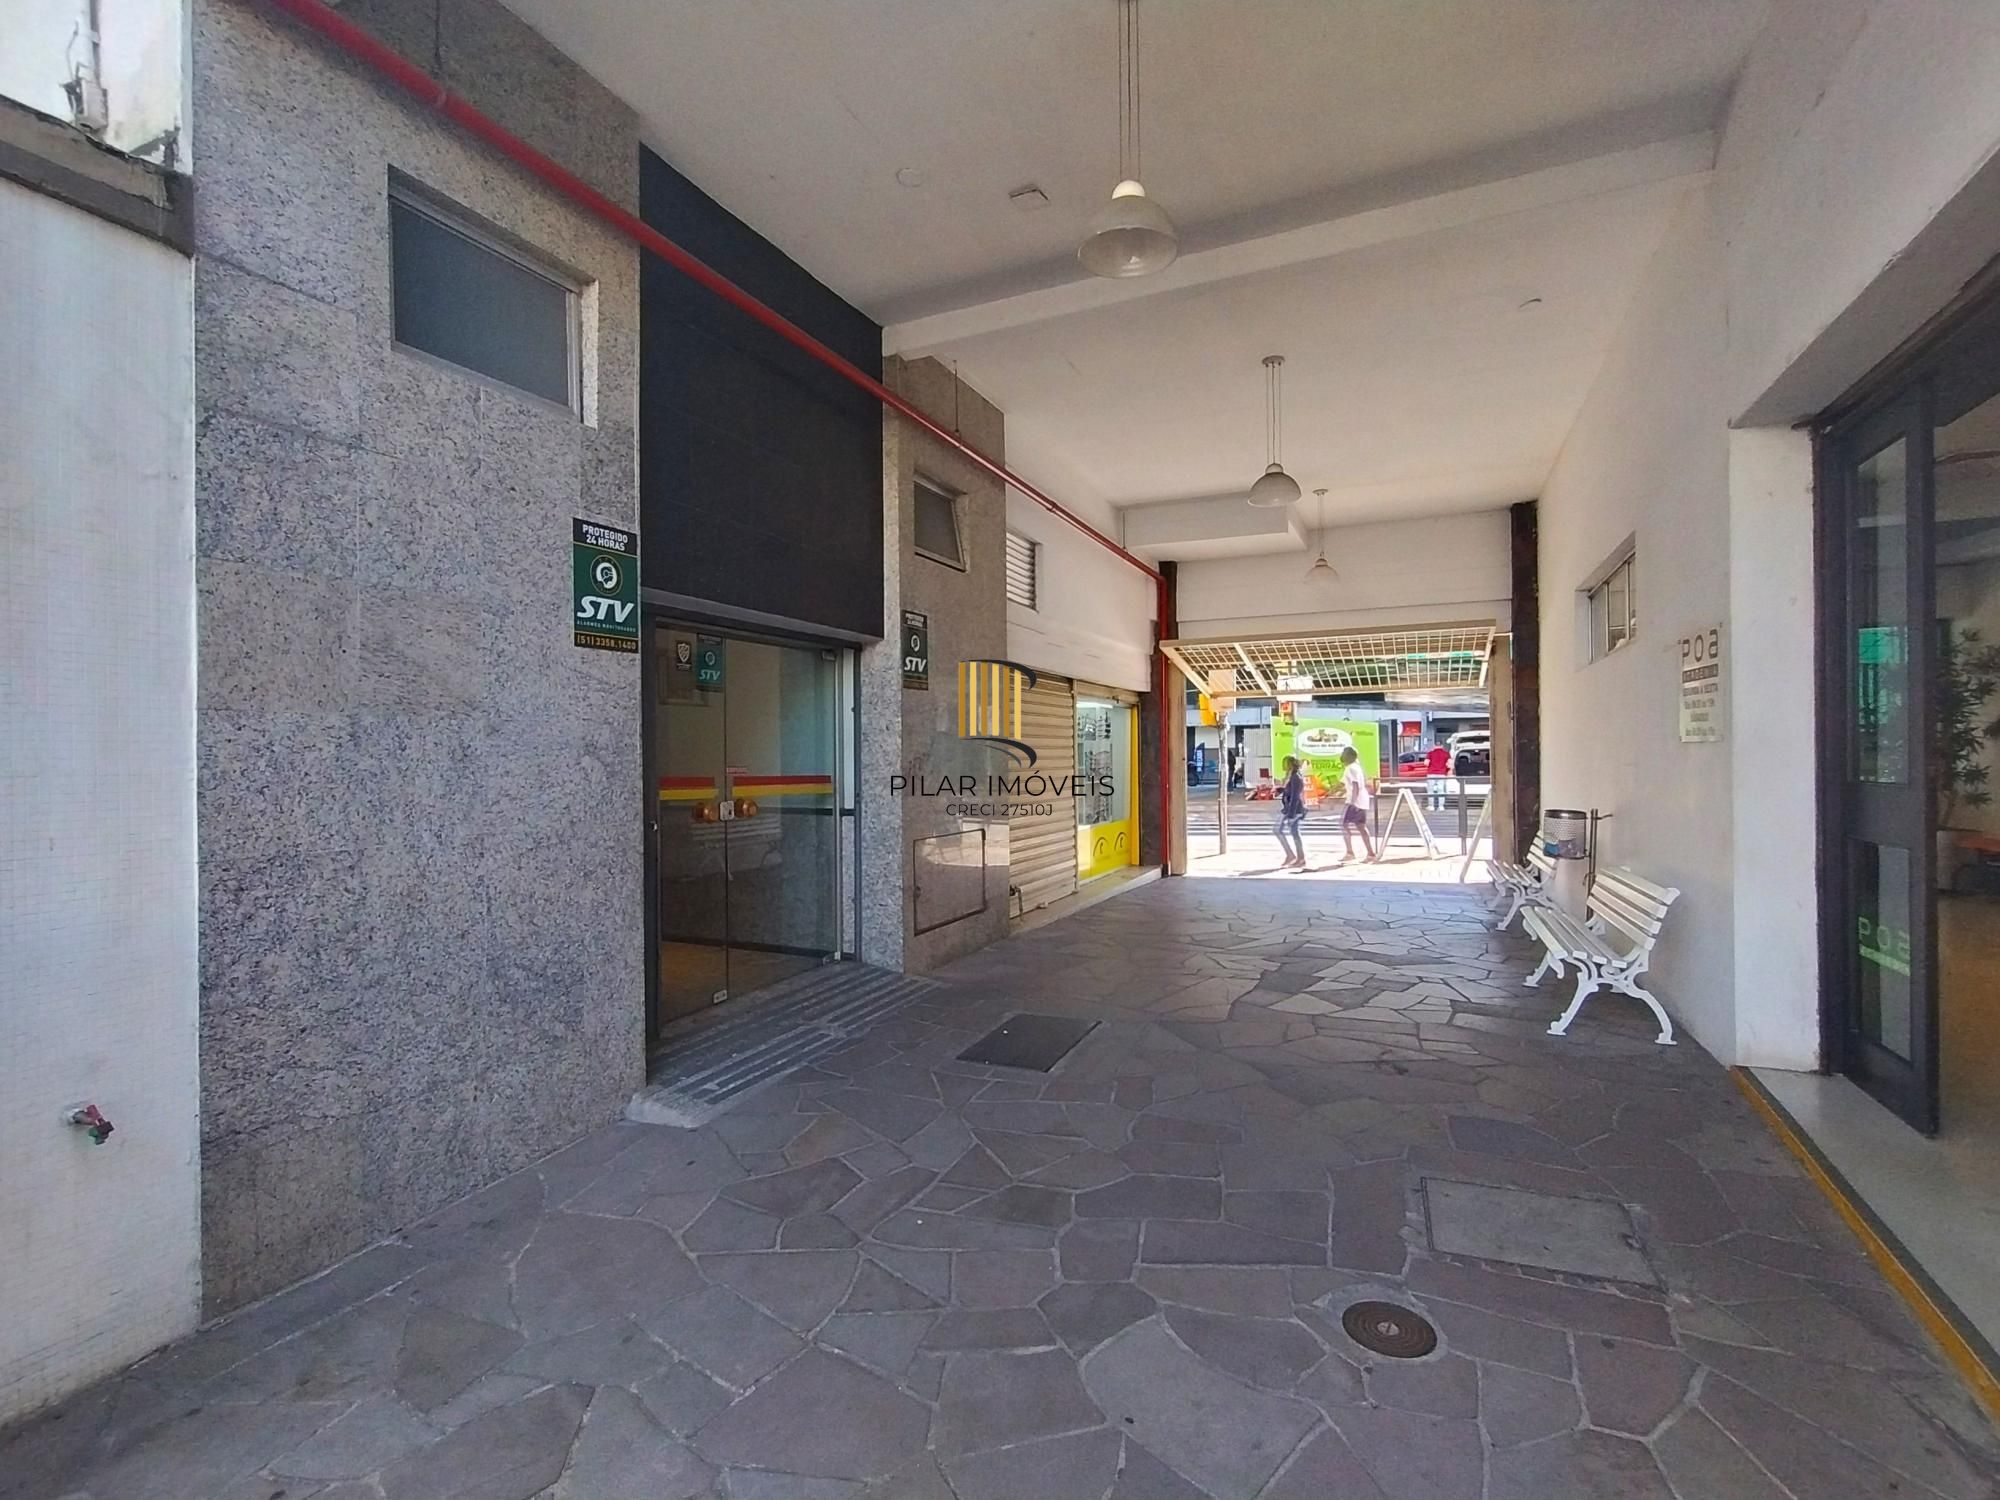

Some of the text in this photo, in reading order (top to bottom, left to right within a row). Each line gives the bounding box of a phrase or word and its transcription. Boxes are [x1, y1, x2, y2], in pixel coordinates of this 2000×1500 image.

[582, 524, 628, 543] PROTEGIDO
[586, 534, 626, 551] 24 HORAS
[577, 595, 635, 624] STV
[904, 656, 927, 672] STV
[699, 669, 721, 681] STV
